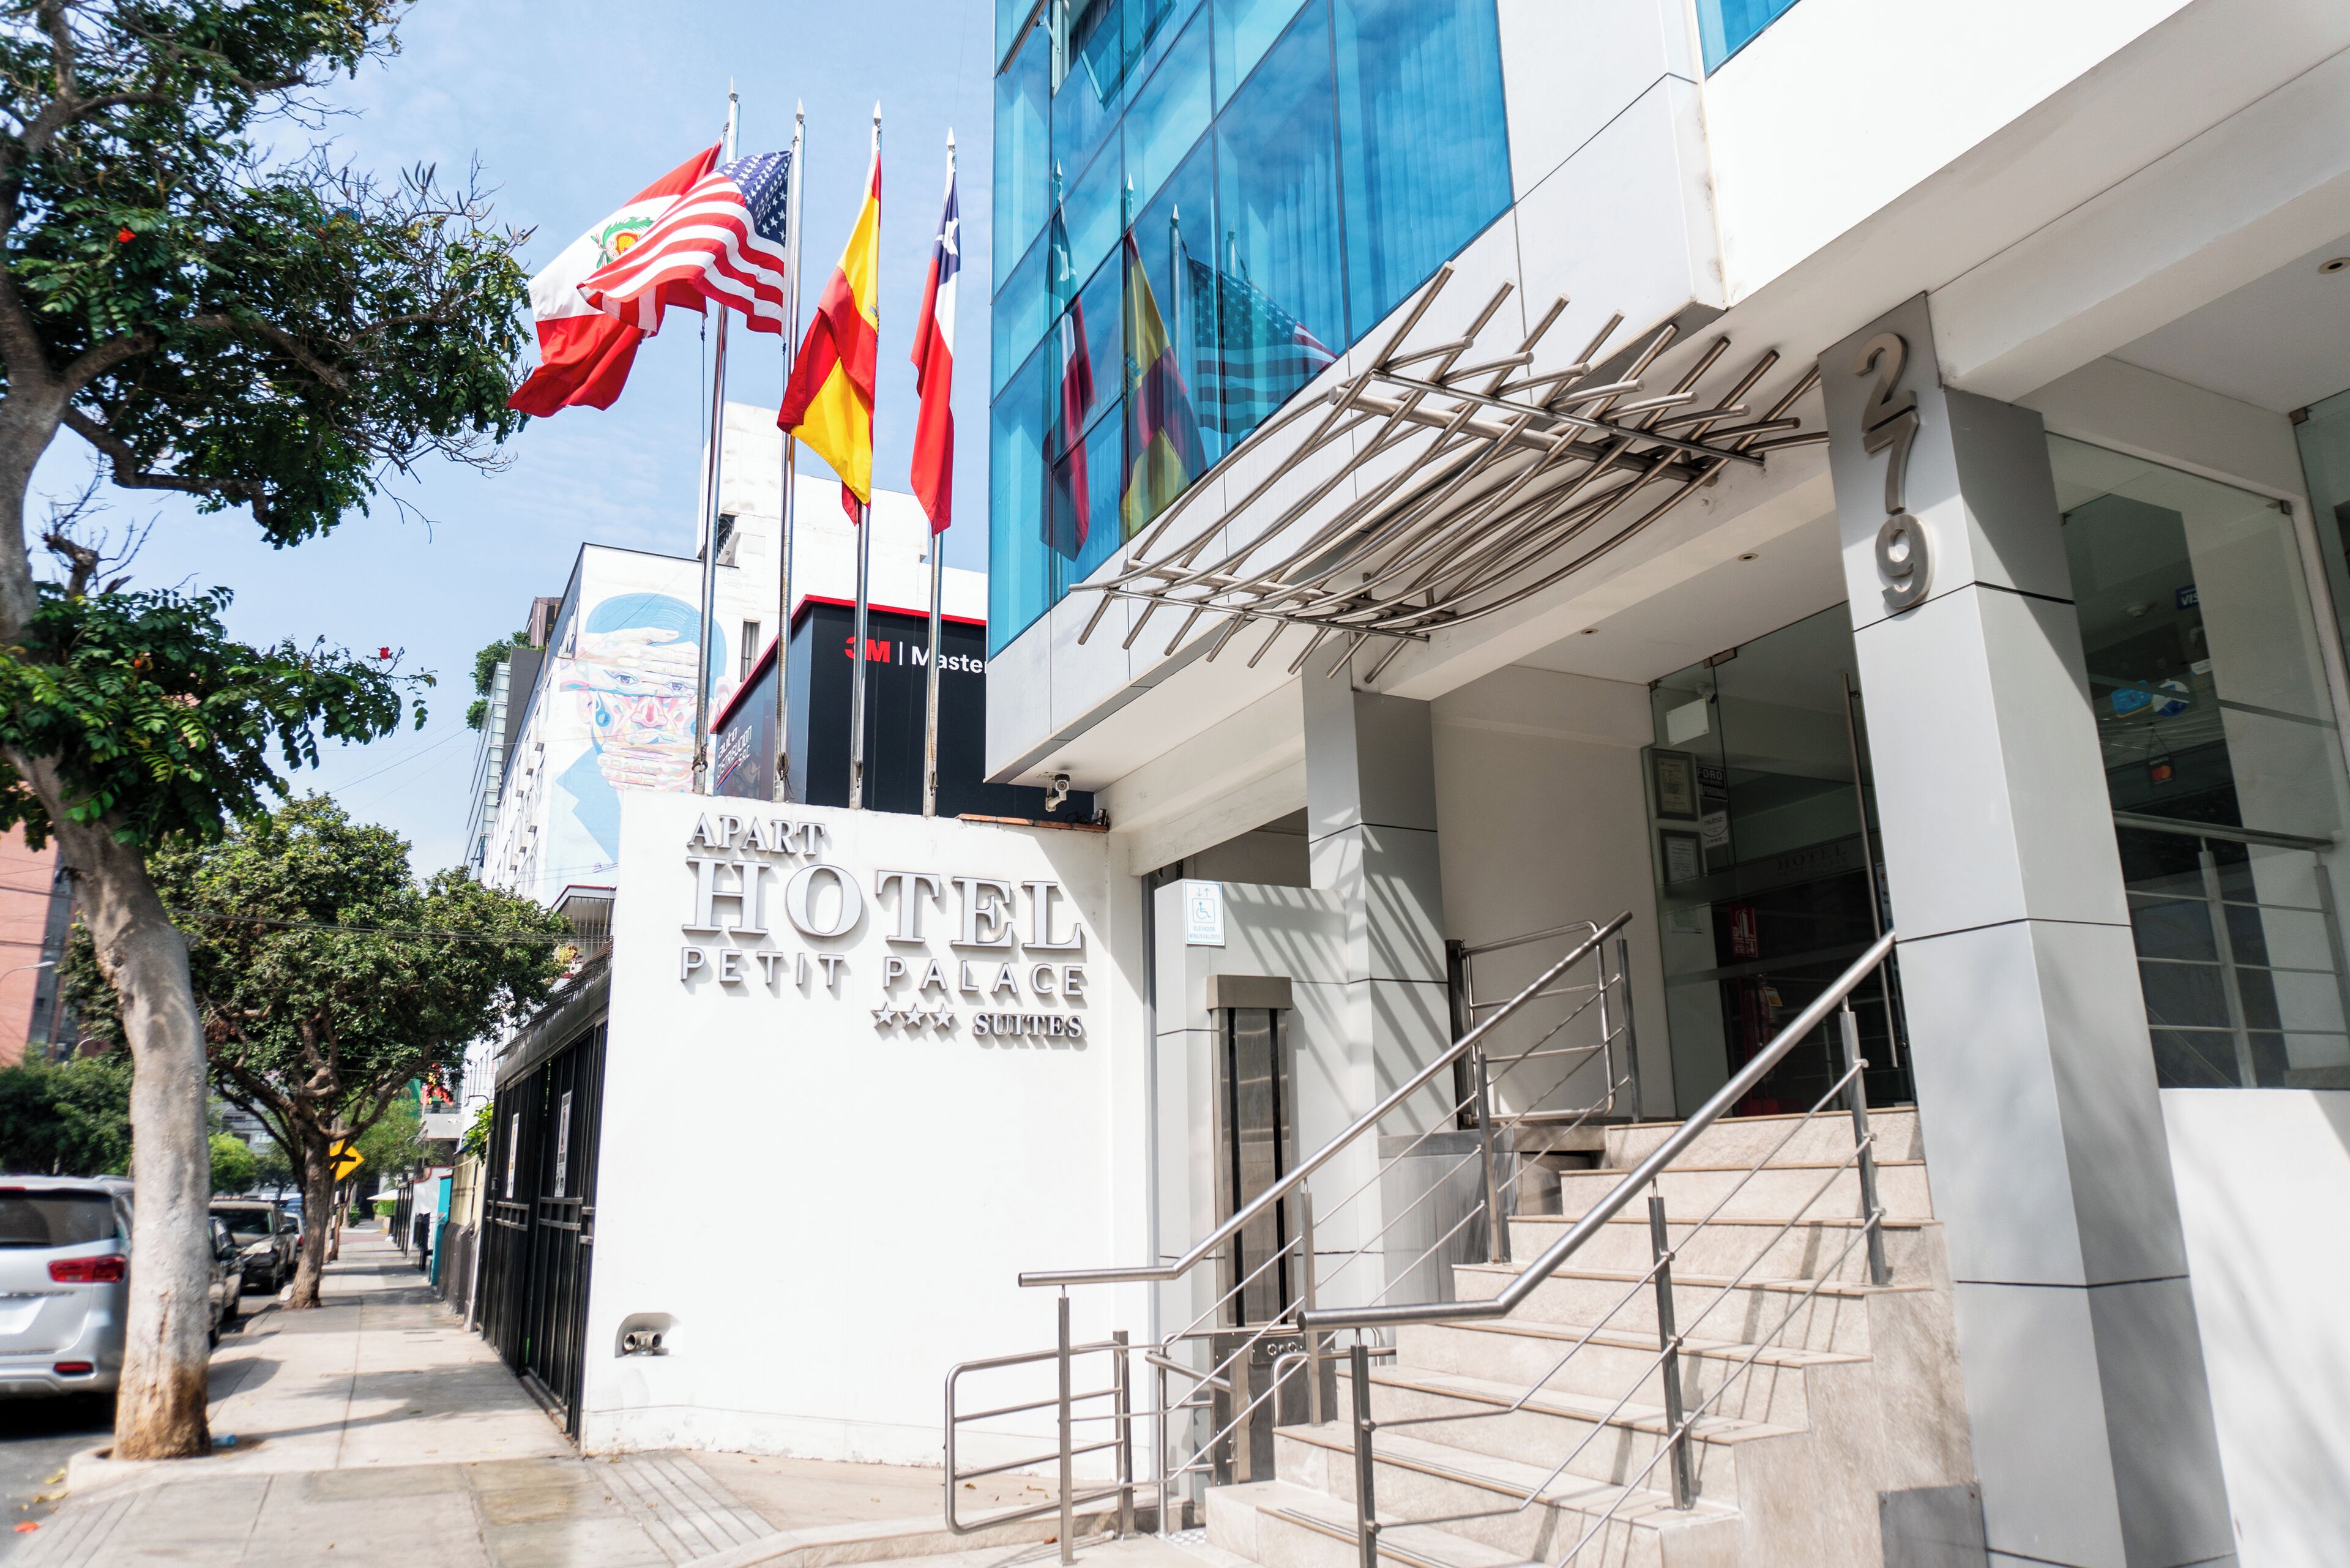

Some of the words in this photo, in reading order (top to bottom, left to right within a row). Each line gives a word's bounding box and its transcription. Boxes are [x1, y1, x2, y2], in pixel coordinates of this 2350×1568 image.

[1855, 332, 1934, 608] 279
[912, 646, 987, 674] Maste
[687, 812, 824, 855] APART
[682, 856, 1081, 949] HOTEL
[681, 947, 844, 986] PETIT
[882, 956, 1082, 996] PALACE
[972, 1012, 1083, 1038] SUITES
